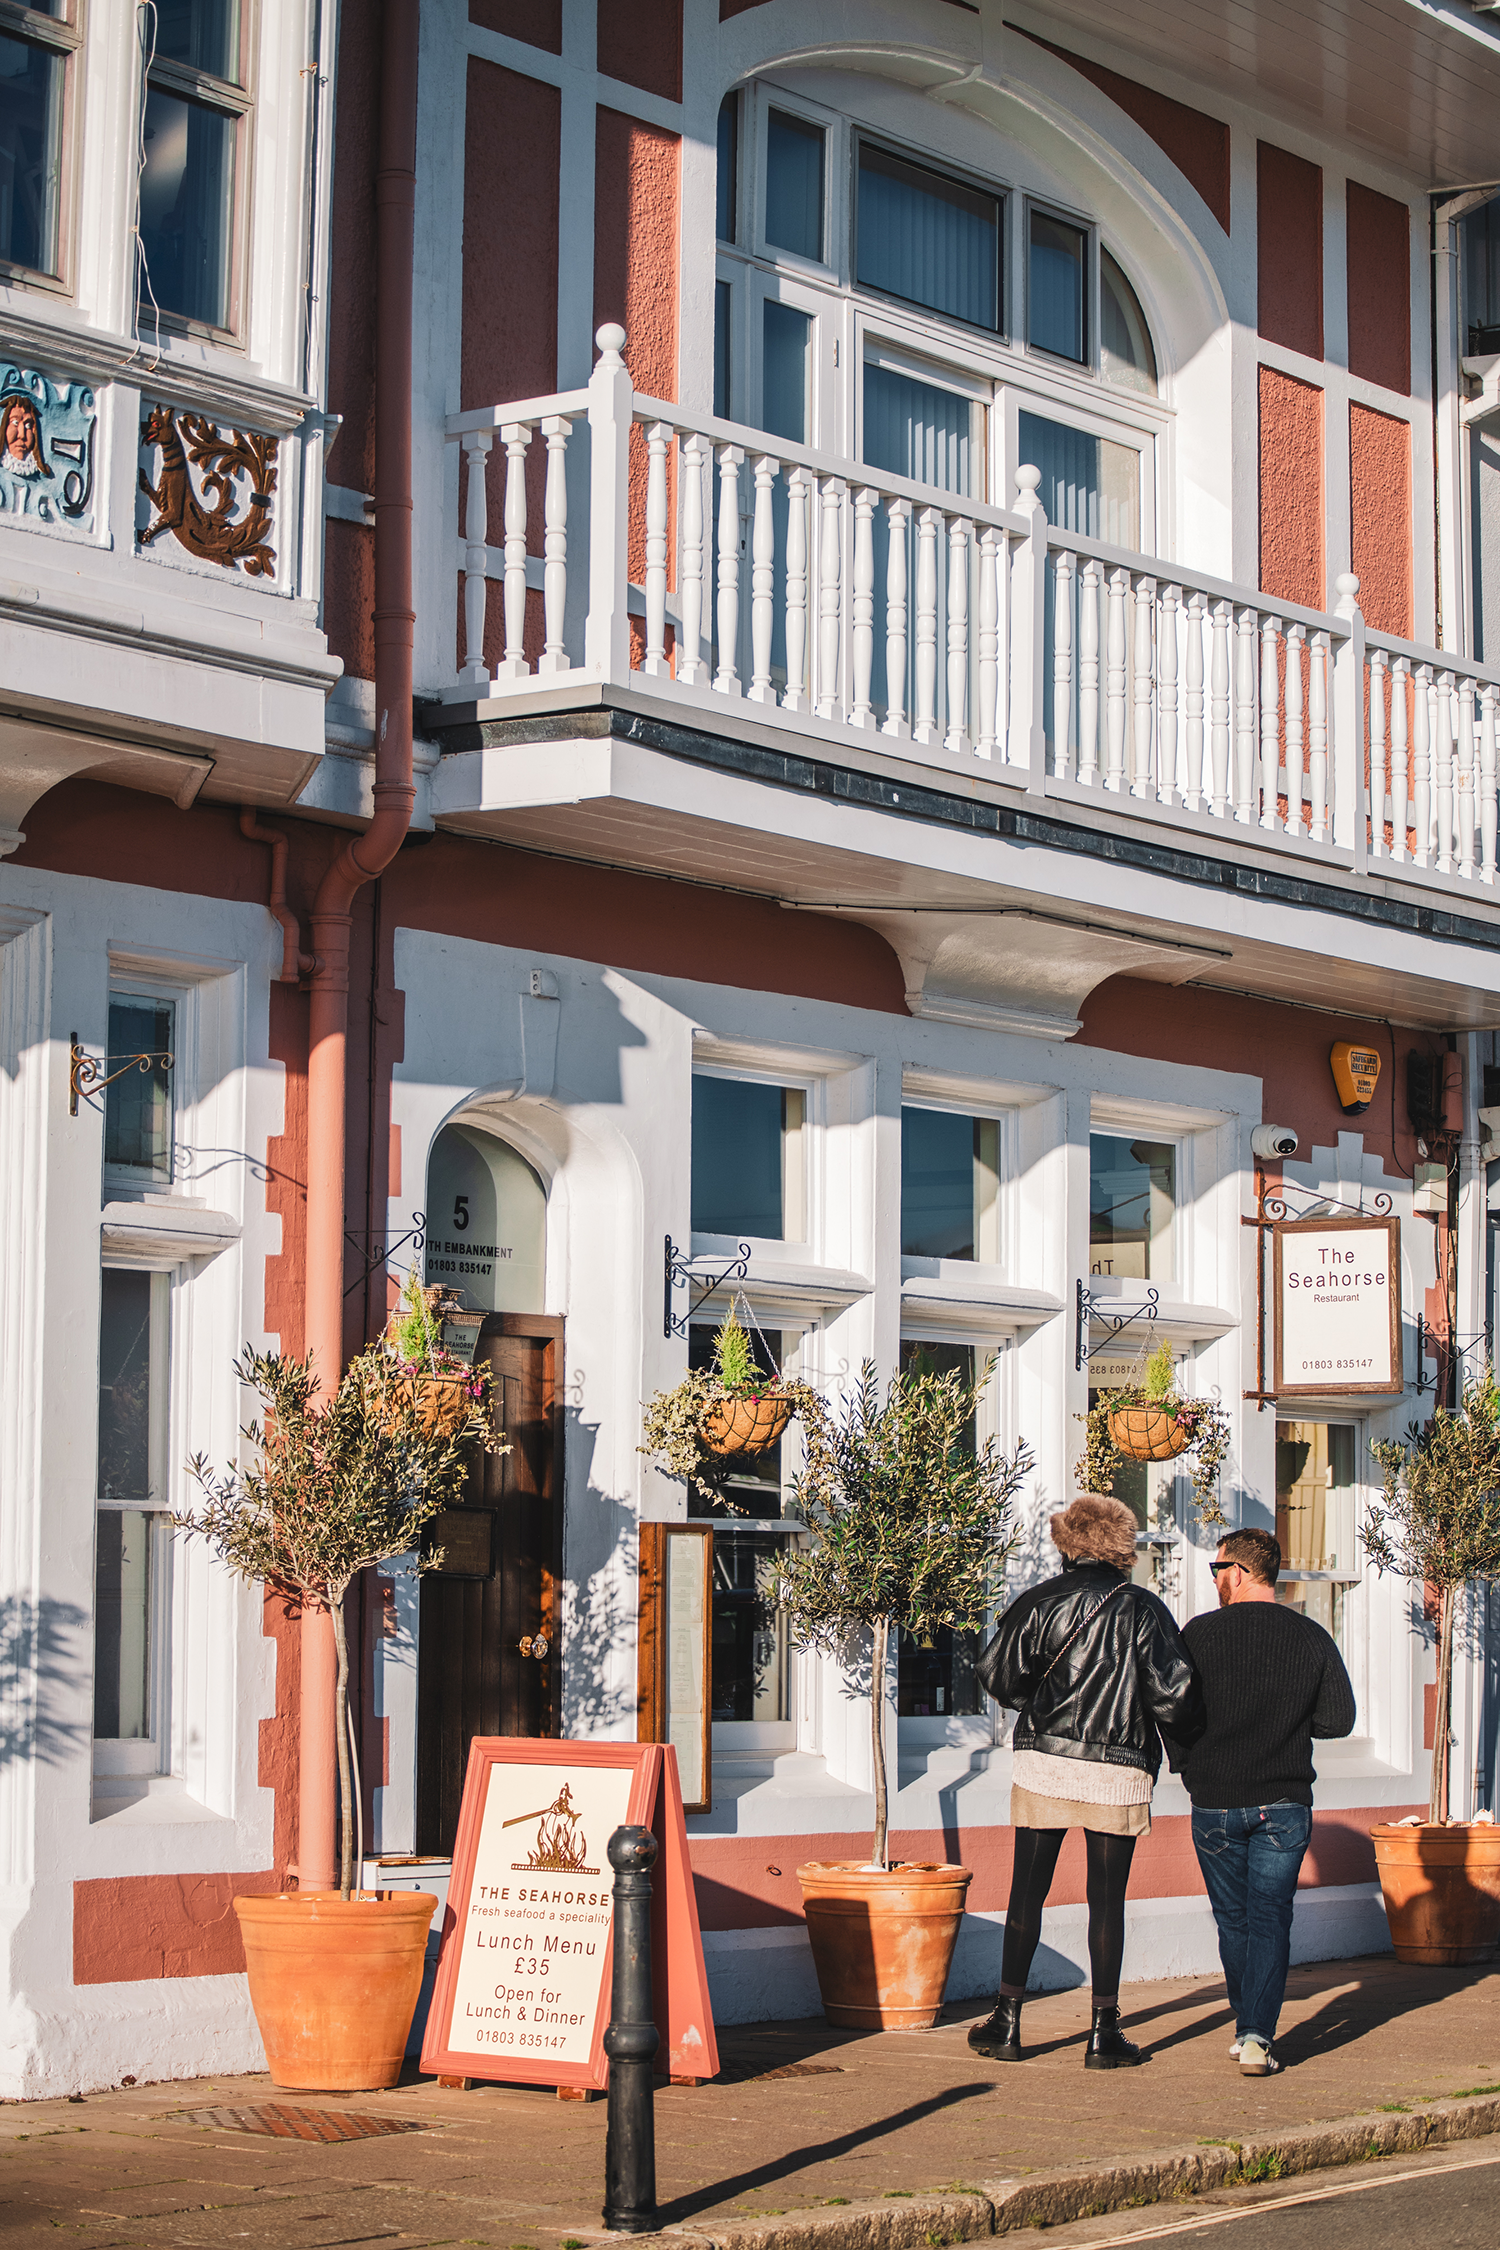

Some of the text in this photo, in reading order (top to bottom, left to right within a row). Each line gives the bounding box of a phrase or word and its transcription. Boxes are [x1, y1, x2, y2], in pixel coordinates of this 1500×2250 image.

[1352, 1063, 1375, 1072] SECURITY
[453, 1195, 470, 1231] 5
[444, 1241, 513, 1259] EMBANKMENT
[1317, 1248, 1356, 1265] The
[428, 1258, 492, 1276] 01803 835147
[1288, 1271, 1386, 1289] Seahorse
[1313, 1292, 1360, 1303] Restaurant
[445, 1340, 474, 1350] SEAHORSE
[455, 1333, 467, 1341] THE
[1302, 1358, 1373, 1370] 01803 835147
[480, 1886, 610, 1907] THE SEAHORSE
[472, 1905, 611, 1927] Fresh seafood a speciality
[477, 1930, 597, 1956] Lunch Menu
[514, 1956, 550, 1976] £35
[494, 1984, 562, 2005] Open for
[466, 2002, 586, 2026] Lunch & Dinner
[476, 2029, 567, 2049] 01803 835147
